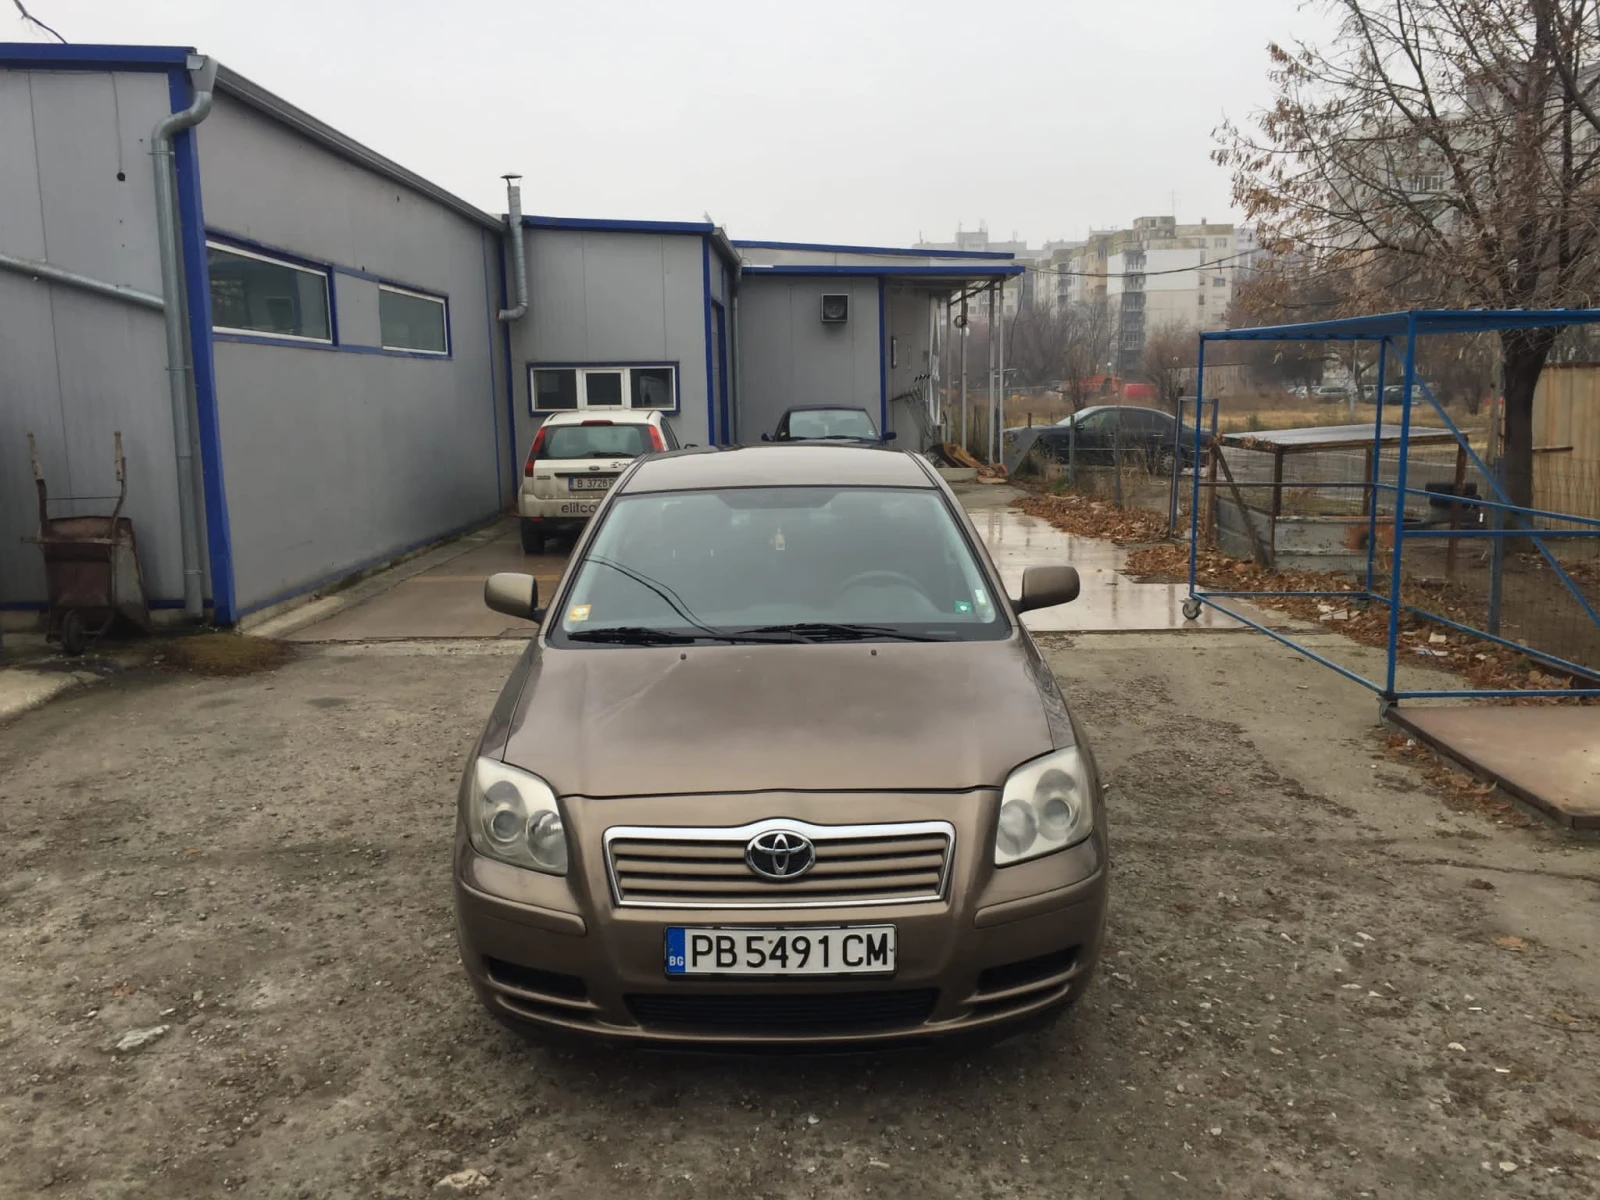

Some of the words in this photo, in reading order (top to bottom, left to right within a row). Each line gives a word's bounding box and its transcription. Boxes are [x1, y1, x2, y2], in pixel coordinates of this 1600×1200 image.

[577, 479, 583, 488] B
[692, 934, 738, 968] PB
[746, 935, 830, 968] 5491
[842, 932, 888, 967] CM
[669, 955, 684, 967] BG
